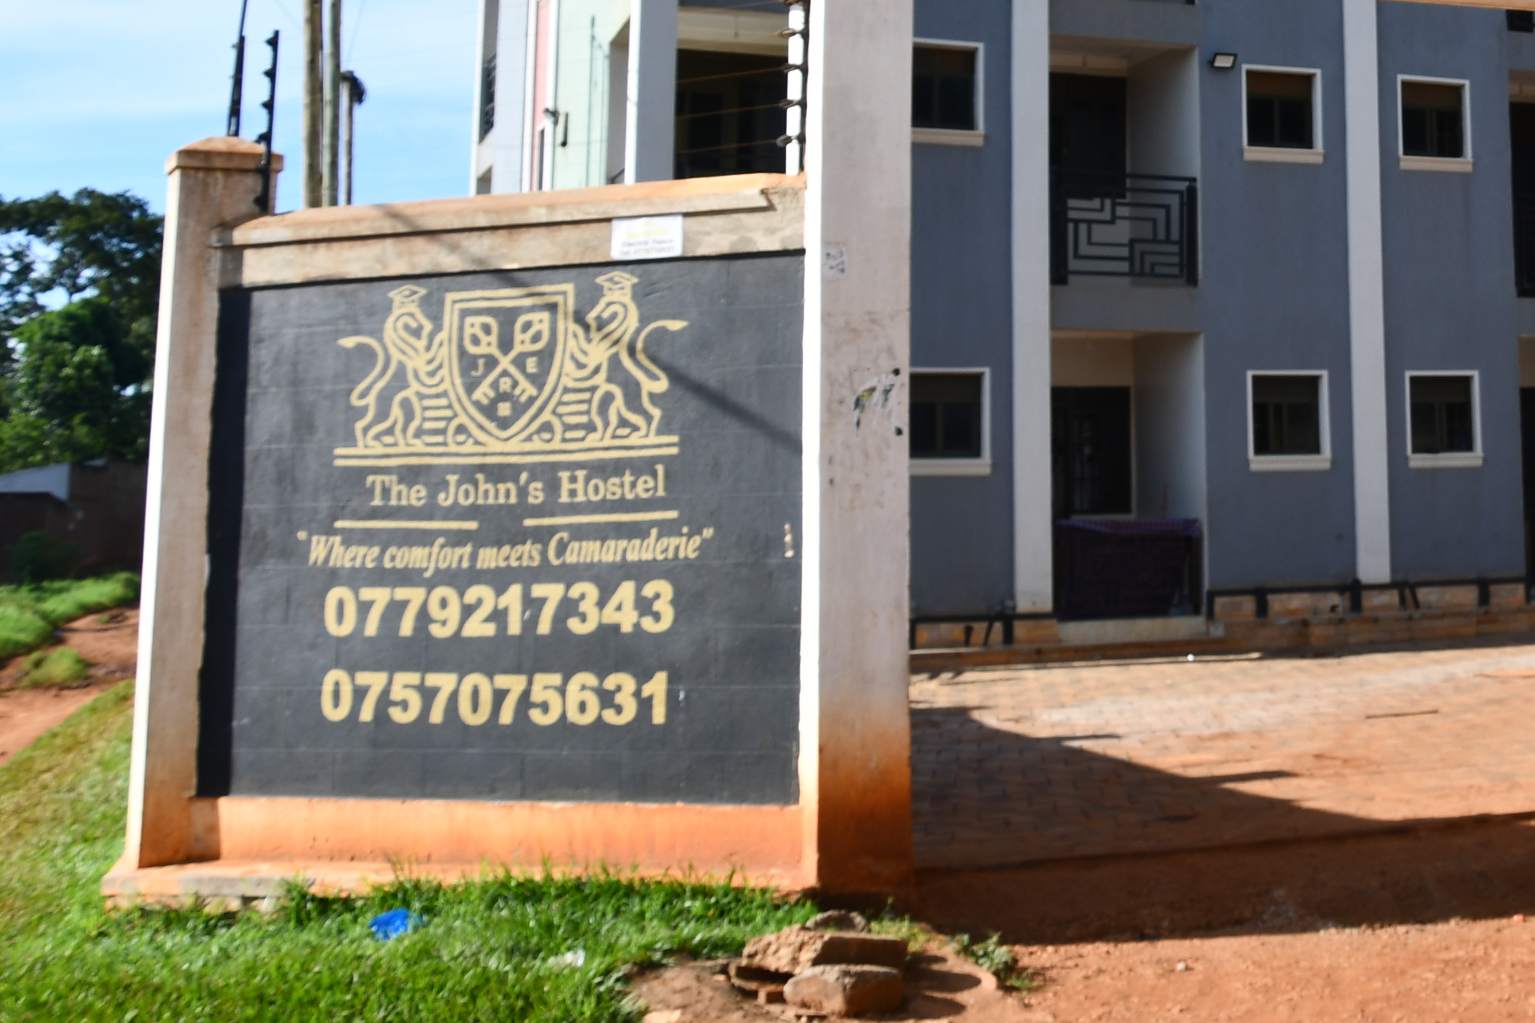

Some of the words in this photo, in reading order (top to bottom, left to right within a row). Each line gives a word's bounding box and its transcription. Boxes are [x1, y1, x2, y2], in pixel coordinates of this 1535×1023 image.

[367, 474, 427, 507] The
[437, 472, 544, 508] John's
[558, 464, 666, 503] Hostel
[383, 537, 474, 578] comfort
[475, 538, 542, 570] meets
[323, 579, 675, 638] 0779217343
[320, 669, 669, 726] 0757075631
